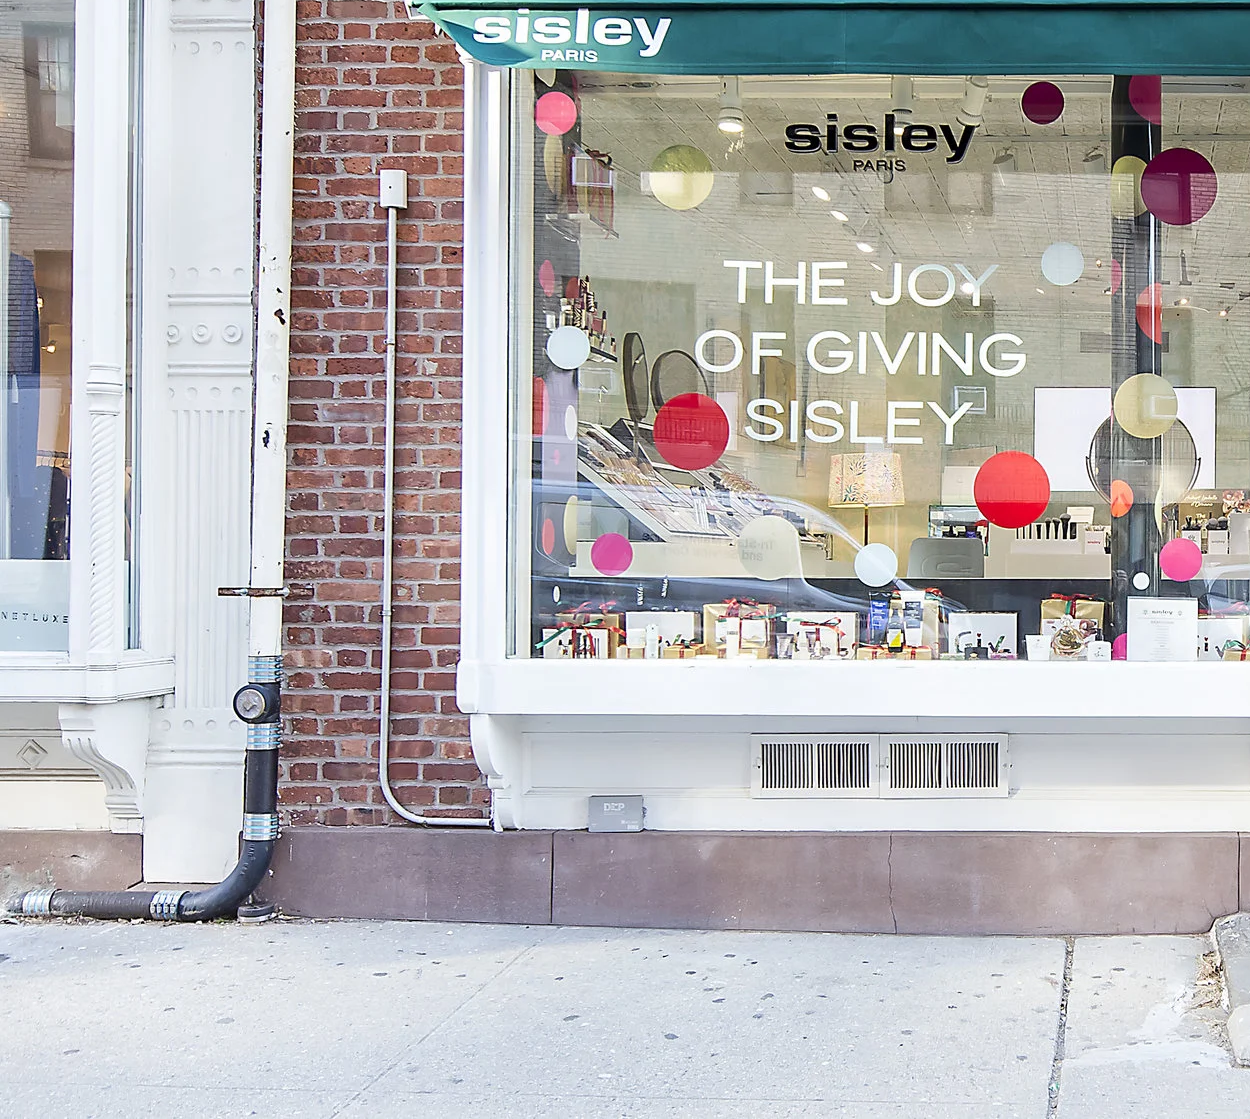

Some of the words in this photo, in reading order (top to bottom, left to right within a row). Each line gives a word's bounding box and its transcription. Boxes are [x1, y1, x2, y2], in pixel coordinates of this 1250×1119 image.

[473, 8, 672, 58] sisley
[541, 49, 599, 63] PARIS
[784, 113, 976, 164] sisley
[853, 159, 907, 172] PARIS
[723, 260, 849, 306] THE
[870, 262, 999, 307] JOY
[694, 330, 787, 375] OF
[806, 330, 1027, 377] GIVING
[744, 398, 974, 445] SISLEY
